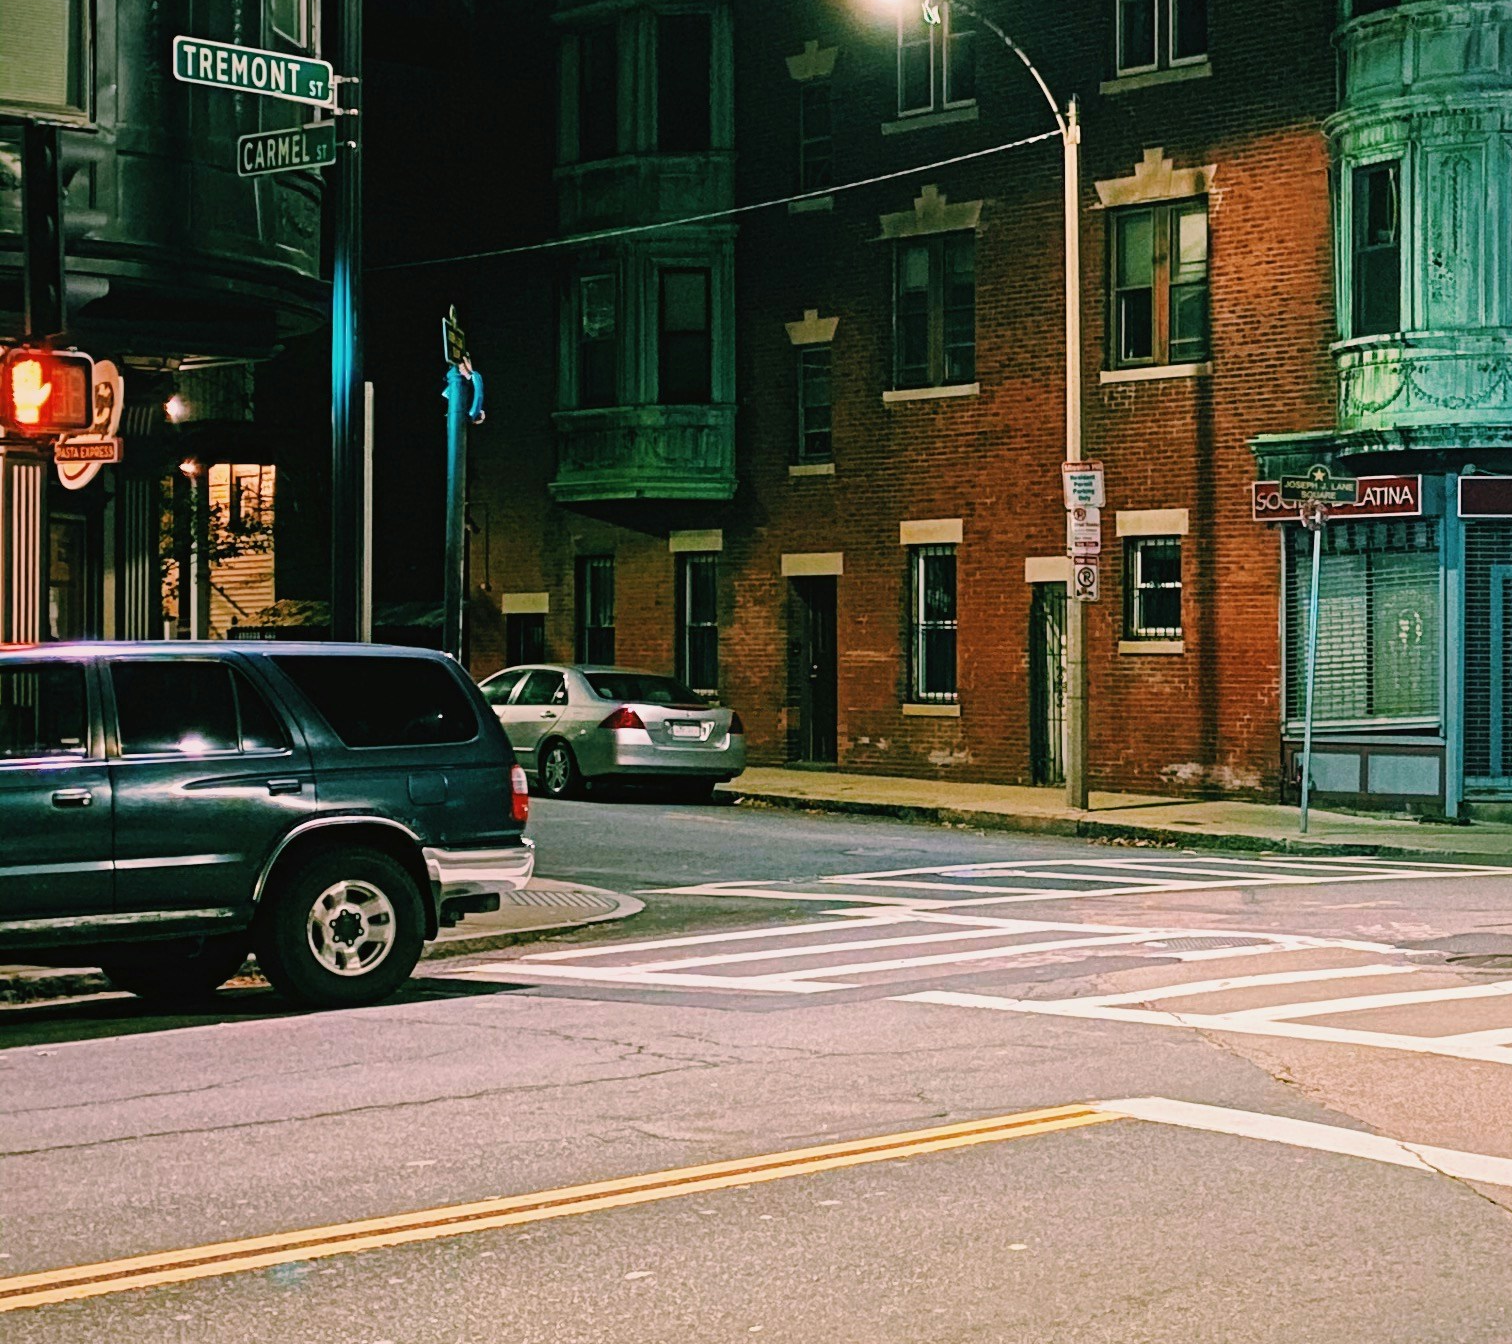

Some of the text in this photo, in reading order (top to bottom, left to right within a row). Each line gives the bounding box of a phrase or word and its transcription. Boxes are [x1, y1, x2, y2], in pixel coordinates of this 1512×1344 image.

[183, 44, 324, 97] TREMONT ST
[243, 133, 328, 172] CARMEL ST
[80, 444, 114, 458] EXPRESS
[1284, 481, 1319, 491] JOSEPH
[1331, 483, 1355, 492] LANE
[1301, 490, 1337, 501] SQUARE
[1353, 486, 1414, 507] ATINA
